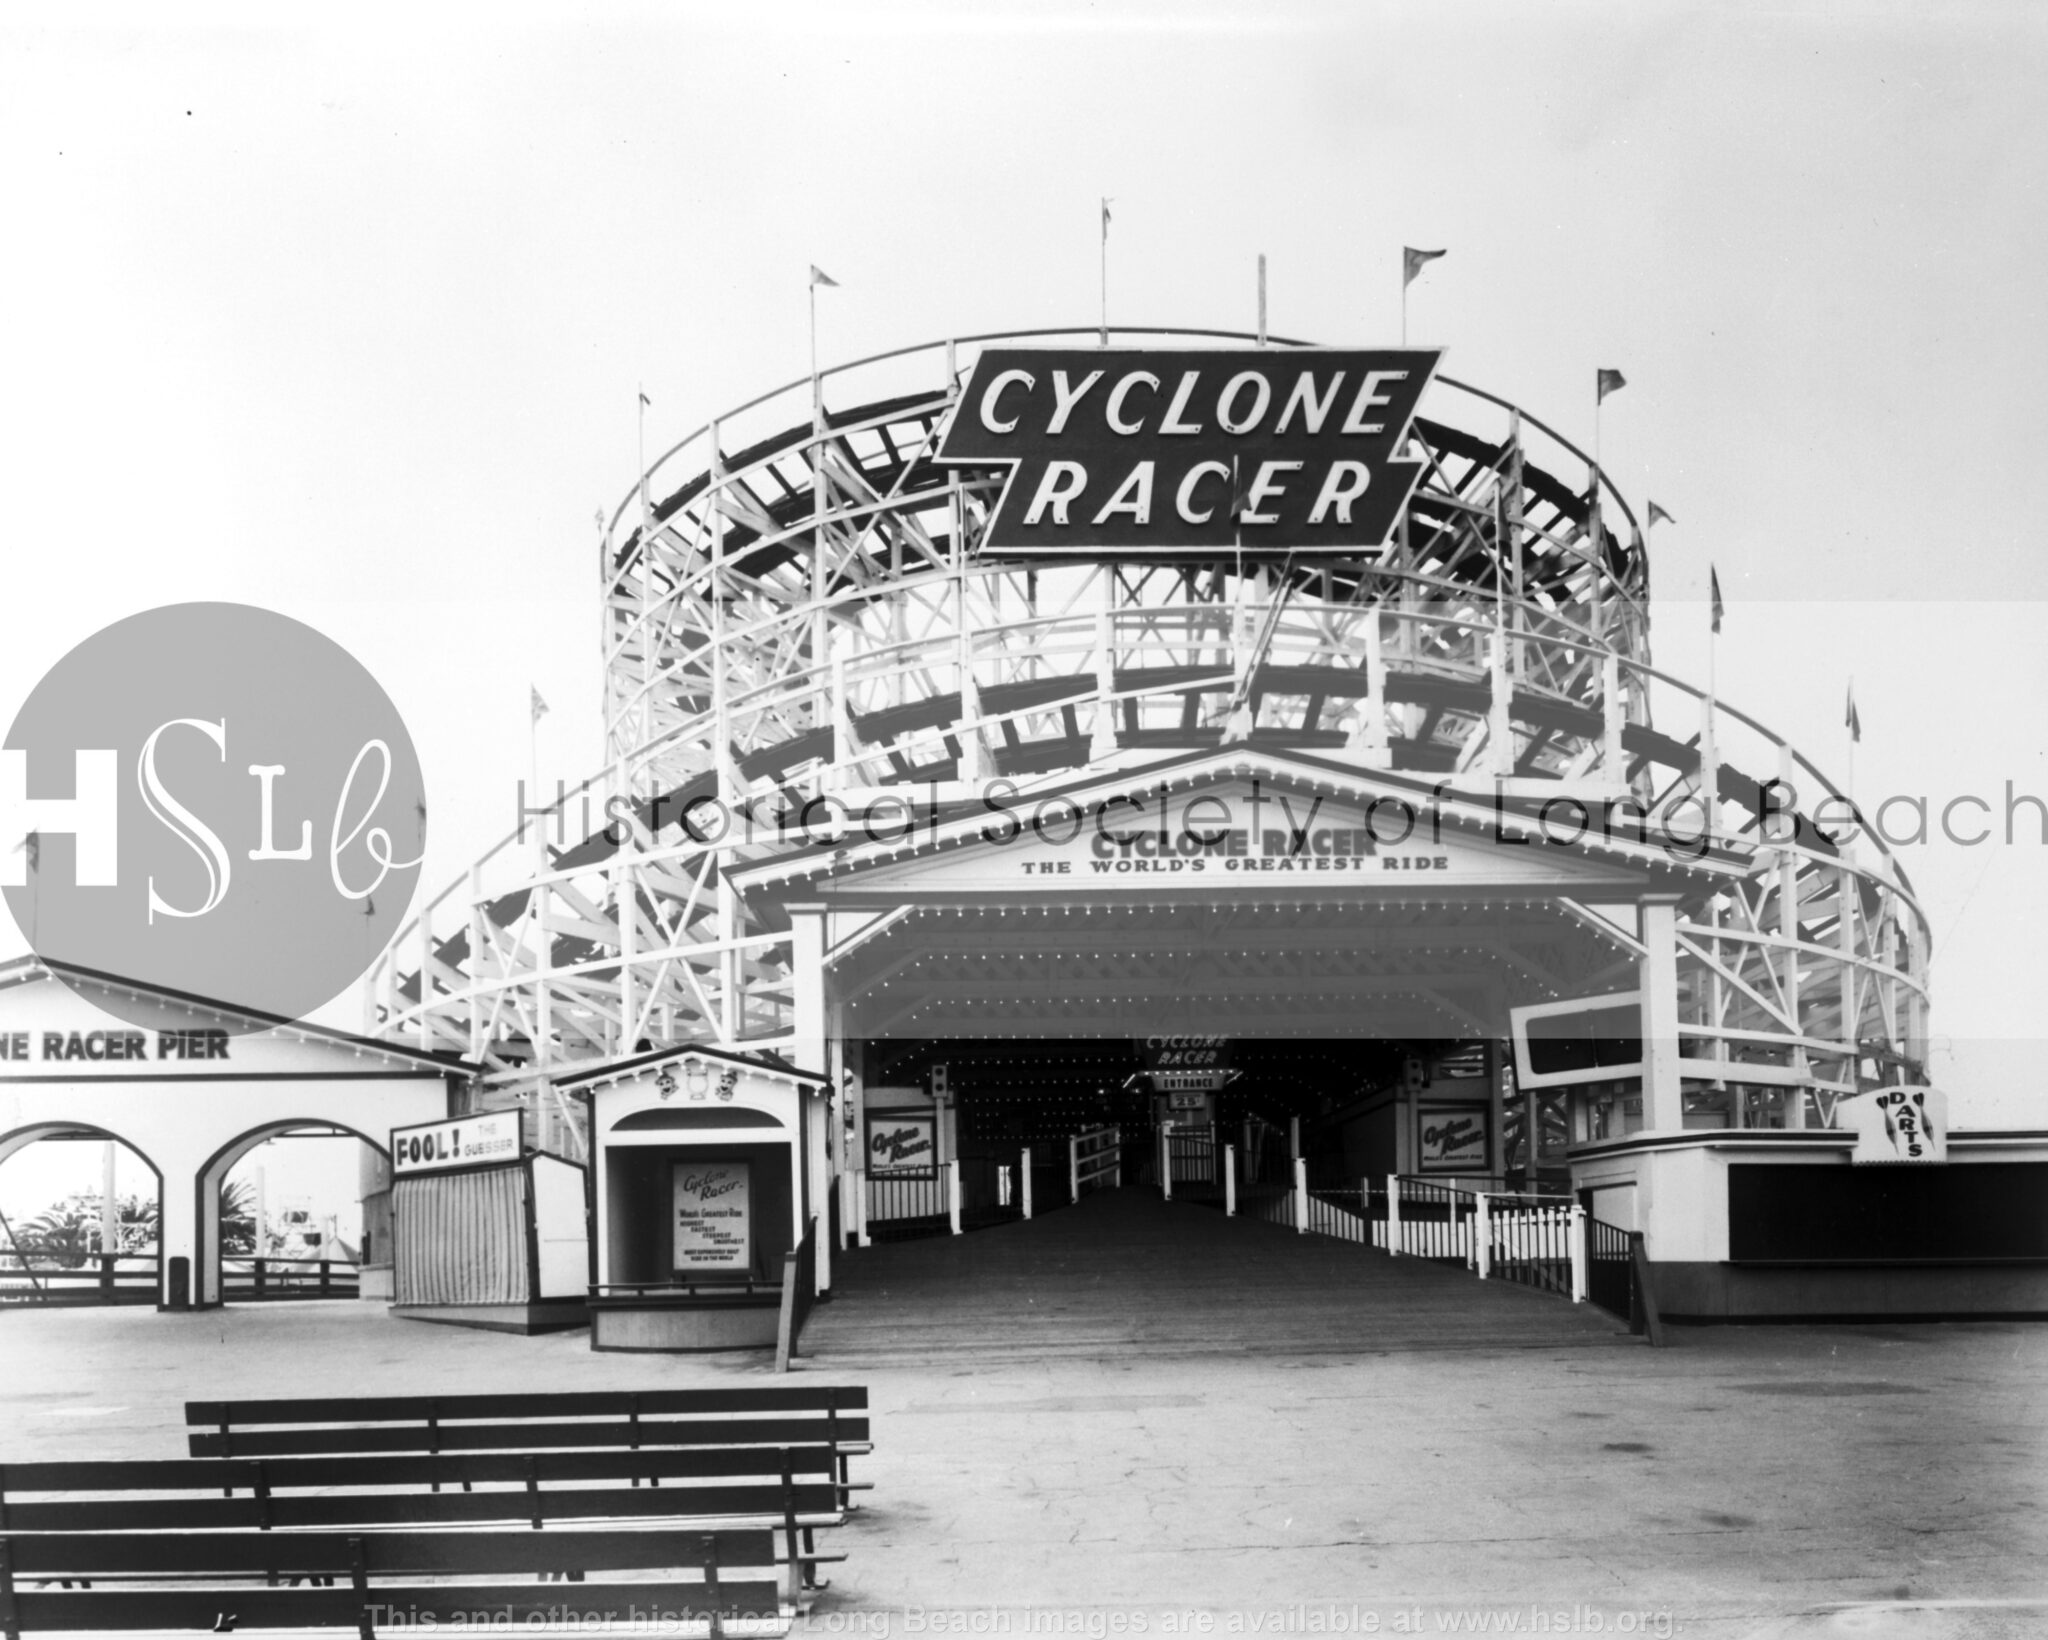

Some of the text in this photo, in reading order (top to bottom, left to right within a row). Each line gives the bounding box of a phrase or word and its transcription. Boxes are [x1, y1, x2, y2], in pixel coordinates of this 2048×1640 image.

[979, 368, 1409, 436] CYCLONE
[1022, 460, 1371, 525] RACER
[1090, 828, 1378, 858] CYCLONE RACER
[1022, 856, 1449, 875] THE WORLD'S GREATEST RIDE
[43, 1030, 149, 1060] RACER
[157, 1028, 231, 1060] PIER
[1146, 1034, 1229, 1048] CYCLONE
[1158, 1050, 1217, 1064] RACER
[1163, 1077, 1214, 1089] ENTRANCE
[478, 1122, 497, 1135] THE
[1889, 1092, 1923, 1157] DARTS
[396, 1128, 460, 1166] FOOL!
[464, 1138, 513, 1157] GUESSER
